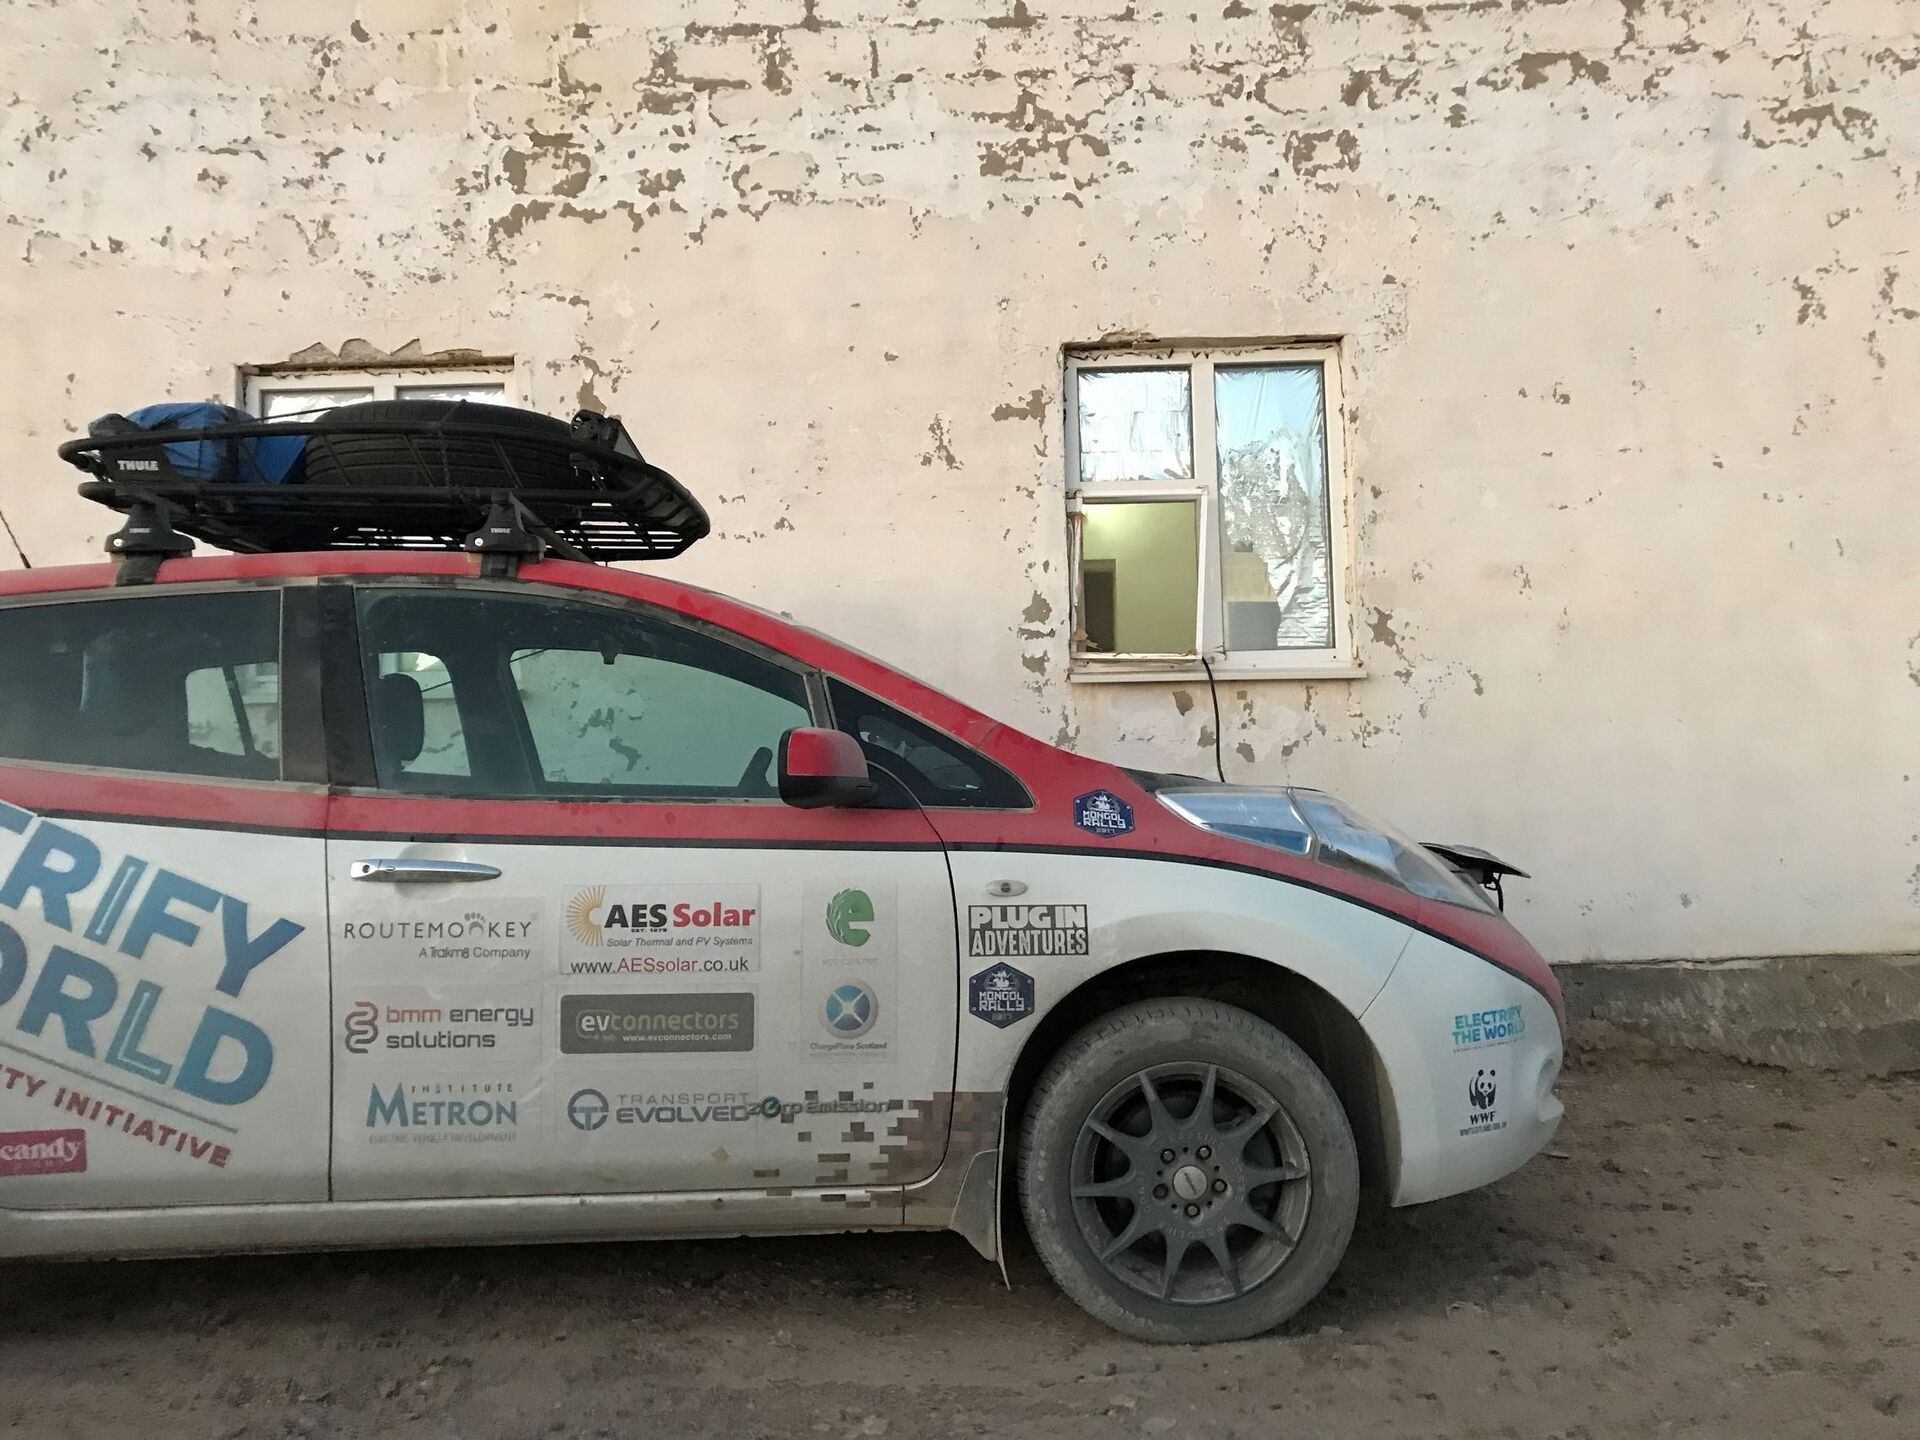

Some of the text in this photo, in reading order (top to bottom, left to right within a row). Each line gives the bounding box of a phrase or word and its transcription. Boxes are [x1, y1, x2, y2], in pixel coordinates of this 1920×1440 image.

[116, 460, 159, 471] THULE
[1082, 810, 1122, 821] MONGOL
[1083, 818, 1126, 829] RALLY
[604, 901, 756, 928] AES Solar
[606, 936, 753, 948] Solar Thermal and PV Systems
[971, 929, 1087, 956] ADVENTURES
[472, 946, 531, 960] Company
[570, 956, 749, 974] www.AESsolar.co.uk
[978, 991, 1025, 1001] MONGOL
[978, 1000, 1025, 1012] RALLY
[386, 1005, 534, 1027] bmm energy
[1455, 1004, 1522, 1030] ELECTRIFY
[386, 1031, 496, 1049] solutions
[1451, 1027, 1481, 1046] THE
[1483, 1020, 1526, 1041] WORLD
[411, 1083, 513, 1095] INSTITUTE
[366, 1081, 517, 1128] METRON
[617, 1092, 750, 1106] TRANSPORT
[0, 1064, 232, 1169] TY INITIATIVE
[616, 1106, 752, 1124] EVOLVED
[1470, 1111, 1496, 1125] WWF
[0, 1136, 81, 1162] candy
